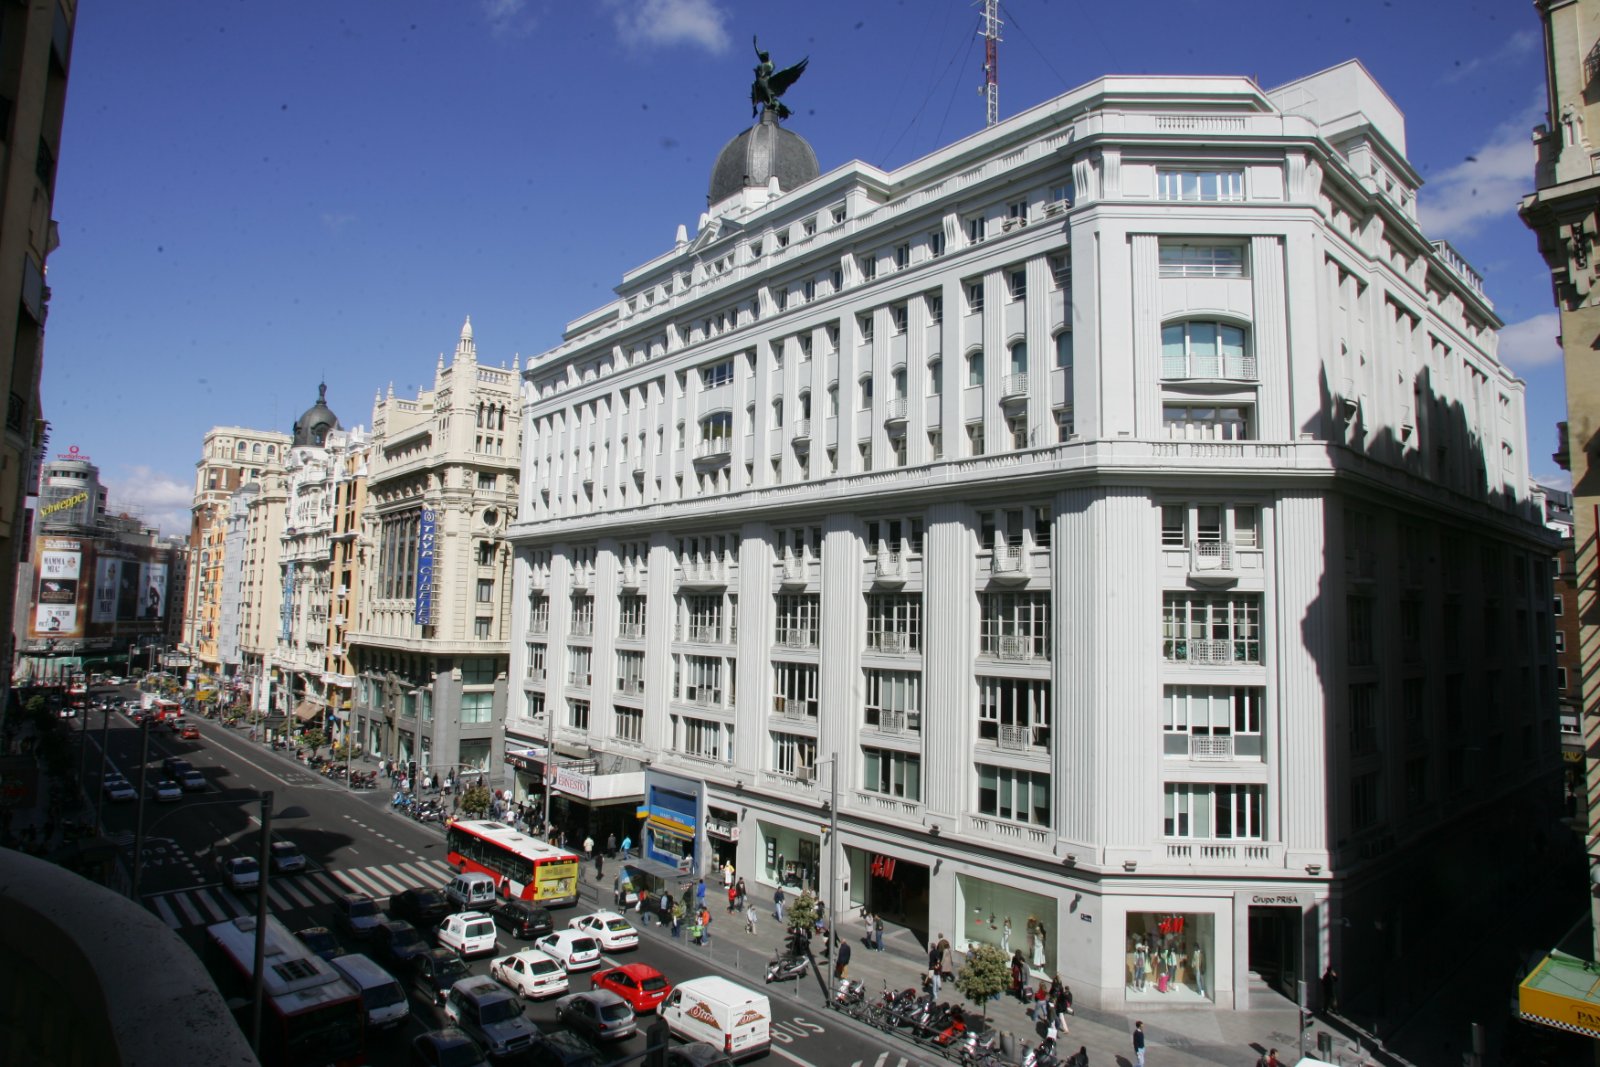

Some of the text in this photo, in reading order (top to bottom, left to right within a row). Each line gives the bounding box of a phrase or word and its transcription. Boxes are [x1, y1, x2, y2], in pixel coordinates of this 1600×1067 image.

[40, 491, 88, 518] Schweppes
[421, 525, 434, 558] TRYP
[417, 566, 432, 624] CIBELES
[558, 775, 586, 793] ERNESTO
[1252, 895, 1298, 904] Grupo PRISA
[770, 1017, 825, 1044] BUS
